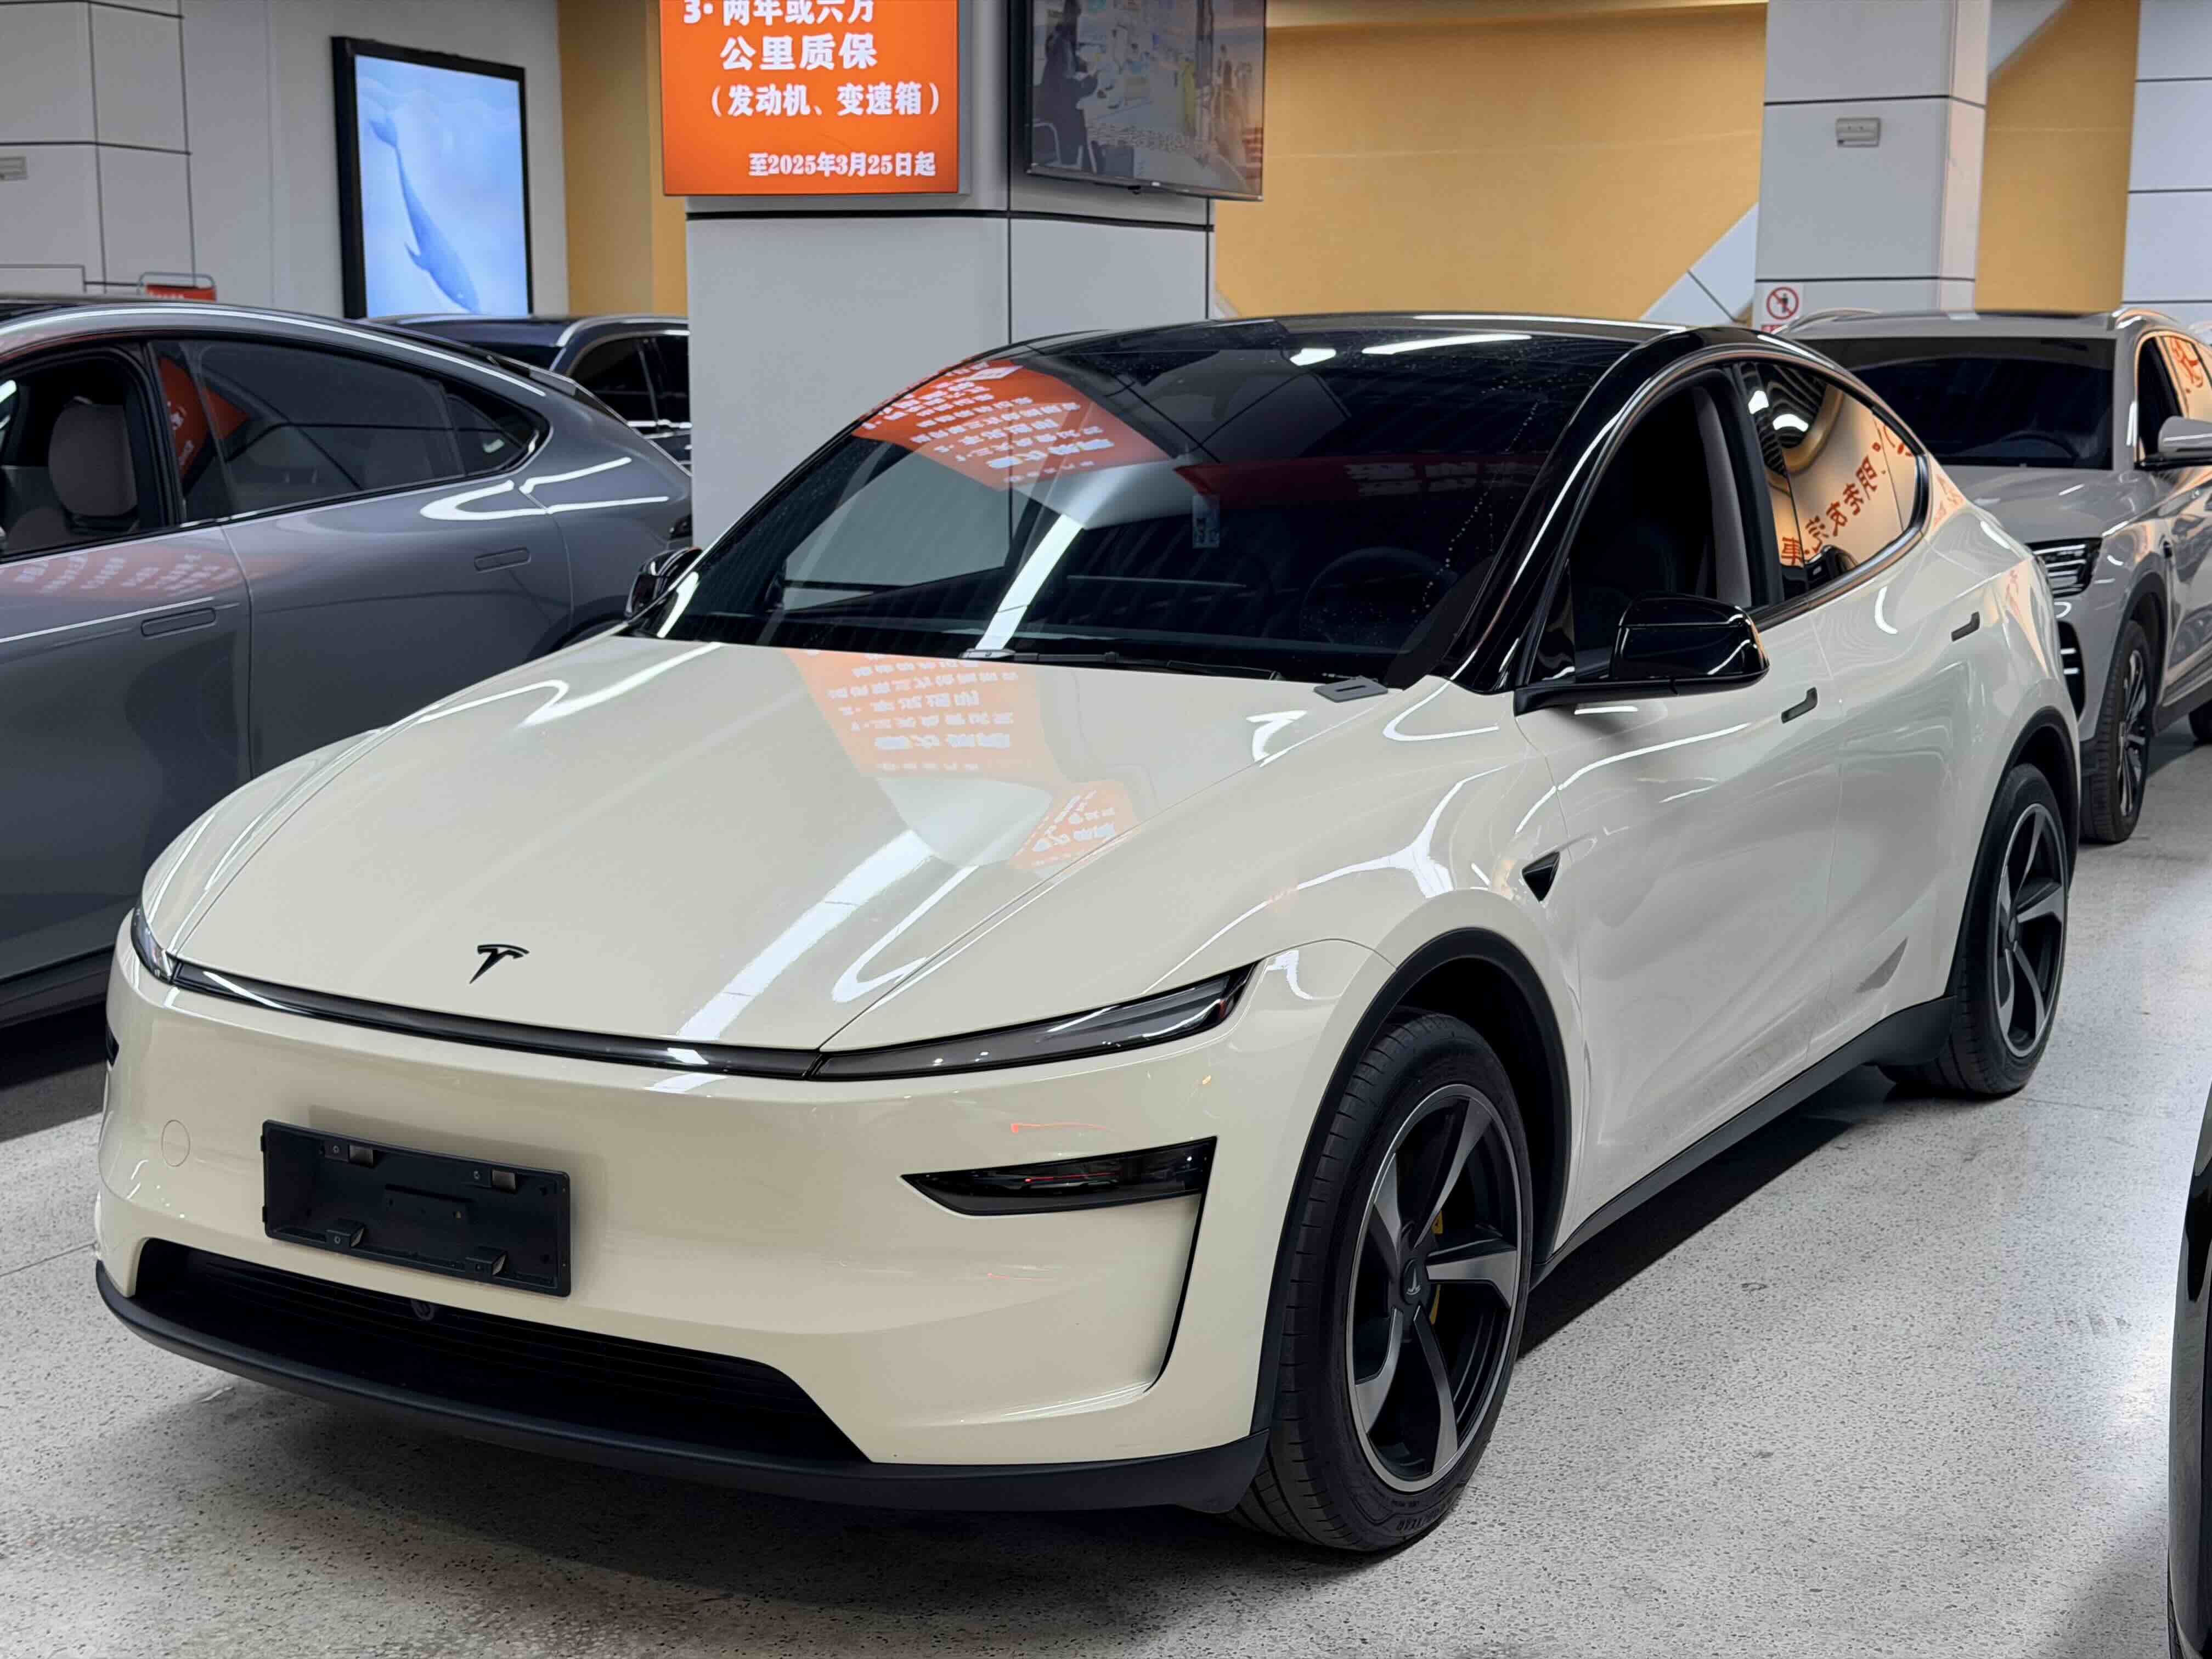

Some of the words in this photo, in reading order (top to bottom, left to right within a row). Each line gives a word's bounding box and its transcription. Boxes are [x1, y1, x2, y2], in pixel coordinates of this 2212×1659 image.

[720, 32, 878, 70] 公里质保
[711, 81, 939, 117] （发动机、变速箱）
[748, 151, 936, 177] 至2025年3月25日起
